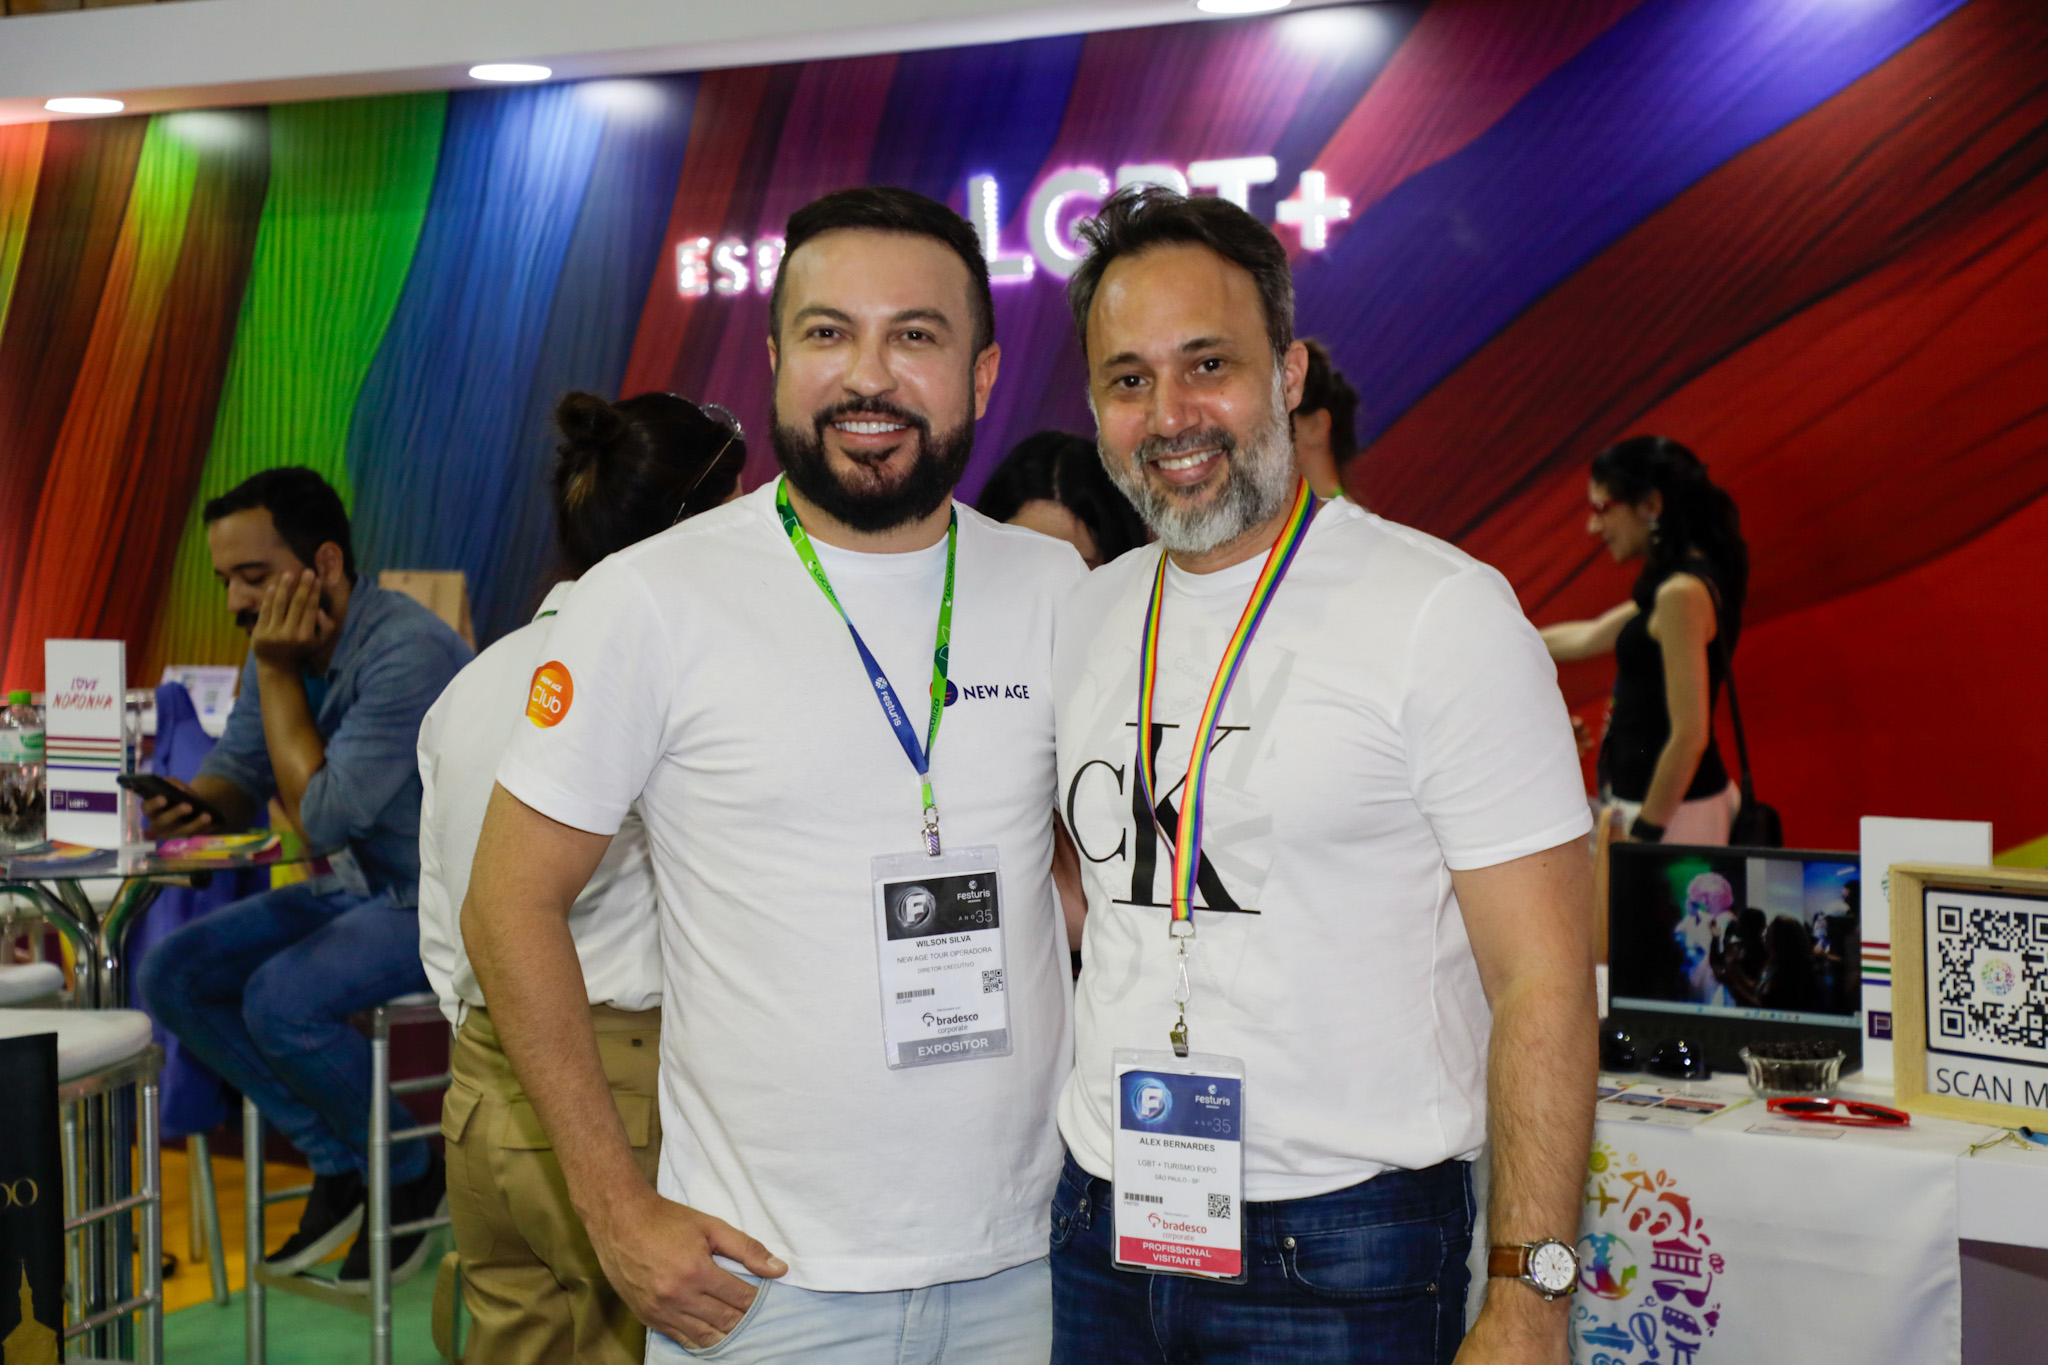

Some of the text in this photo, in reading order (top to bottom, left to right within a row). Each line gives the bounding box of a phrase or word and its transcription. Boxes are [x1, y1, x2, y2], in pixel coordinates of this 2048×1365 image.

[677, 237, 786, 295] ESP
[531, 685, 561, 713] Club
[963, 685, 1030, 700] NEW AGE
[880, 690, 902, 727] Festuris
[957, 888, 991, 901] Festuris
[916, 935, 971, 948] WILSON SILVA
[897, 946, 992, 964] NEW AGE TOUR OPERADORA
[937, 1012, 979, 1026] bradesco
[938, 1025, 968, 1035] corporate
[918, 1037, 989, 1057] EXPOSITOR
[1936, 1068, 2048, 1109] SCAN M
[1195, 1095, 1231, 1107] Festuris
[1140, 1137, 1216, 1152] ALEX BERNARDES
[1138, 1159, 1156, 1168] LGBT
[1163, 1162, 1196, 1172] TURISMO
[1197, 1166, 1217, 1174] EXPO
[1163, 1219, 1208, 1234] bradesco
[1163, 1232, 1195, 1242] corporate
[1142, 1241, 1212, 1258] PROFISSIONAL
[1153, 1253, 1201, 1267] VISITANTE
